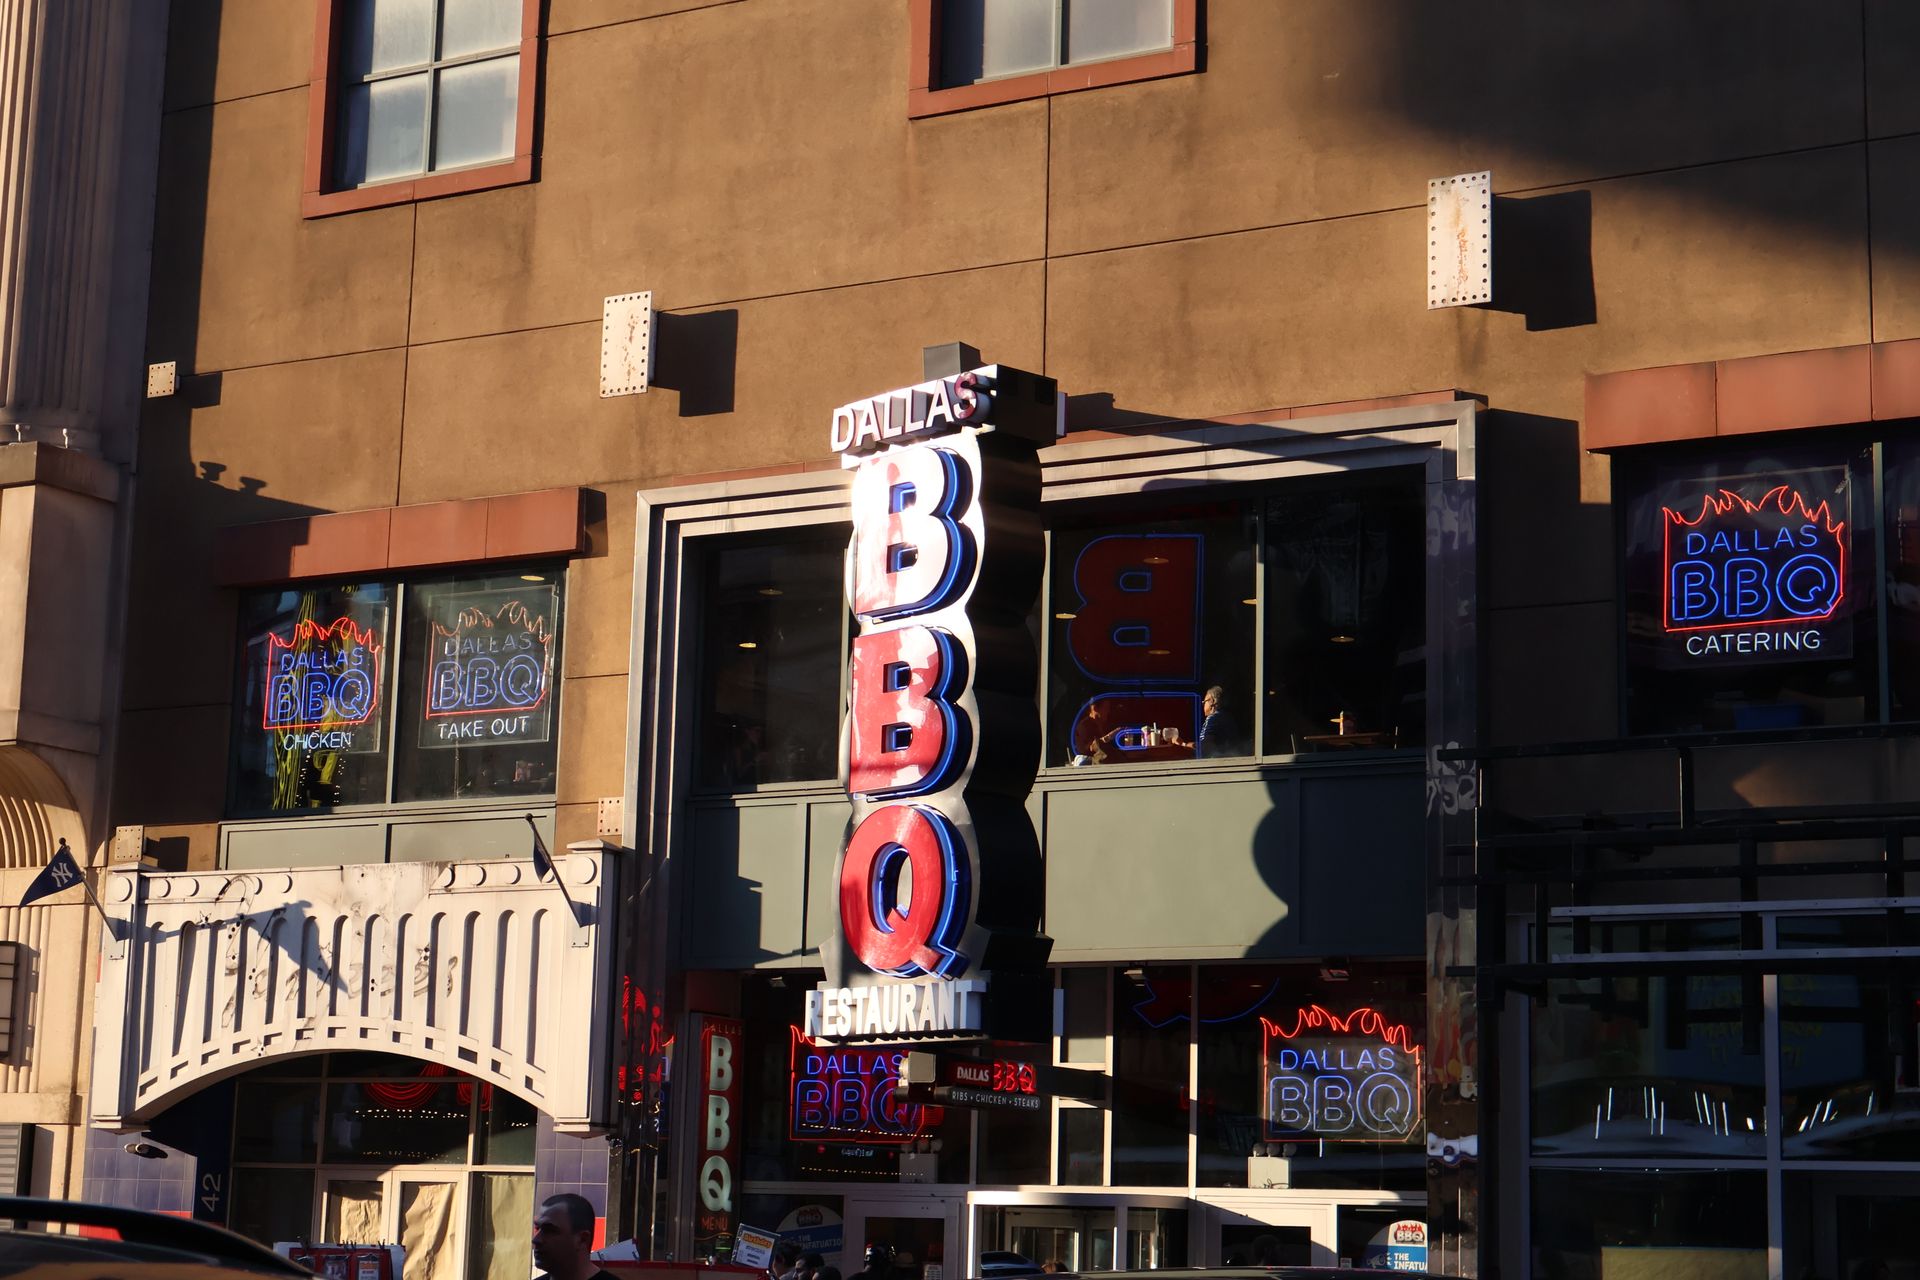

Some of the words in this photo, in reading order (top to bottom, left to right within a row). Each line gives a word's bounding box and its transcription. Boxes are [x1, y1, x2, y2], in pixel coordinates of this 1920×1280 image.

[831, 371, 979, 452] DALLAS
[1686, 524, 1818, 556] DALLAS
[1671, 553, 1839, 621] BBQ
[280, 646, 364, 671] DALLAS
[444, 631, 532, 657] DALLAS
[1686, 630, 1821, 656] CATERING
[270, 668, 372, 722] BBQ
[431, 654, 540, 710] BBQ
[438, 719, 484, 740] TAKE
[491, 715, 530, 736] OUT
[839, 445, 977, 980] BBQ
[283, 731, 352, 751] CHICKEN
[805, 980, 986, 1037] RESTAURANT
[806, 1054, 905, 1075] DALLAS
[1280, 1047, 1396, 1071] DALLAS
[956, 1066, 990, 1082] DALLAS
[993, 1060, 1038, 1094] BBQ
[796, 1076, 919, 1134] BBQ
[952, 1091, 968, 1101] RIBS
[975, 1094, 1007, 1105] CHICKEN
[1013, 1098, 1040, 1109] STEAKS
[1269, 1072, 1412, 1134] BBQ
[700, 1036, 733, 1213] BBQ
[201, 1173, 222, 1213] 42
[700, 1214, 728, 1232] MENU
[1395, 1230, 1424, 1242] BBQ
[1393, 1253, 1410, 1261] THE
